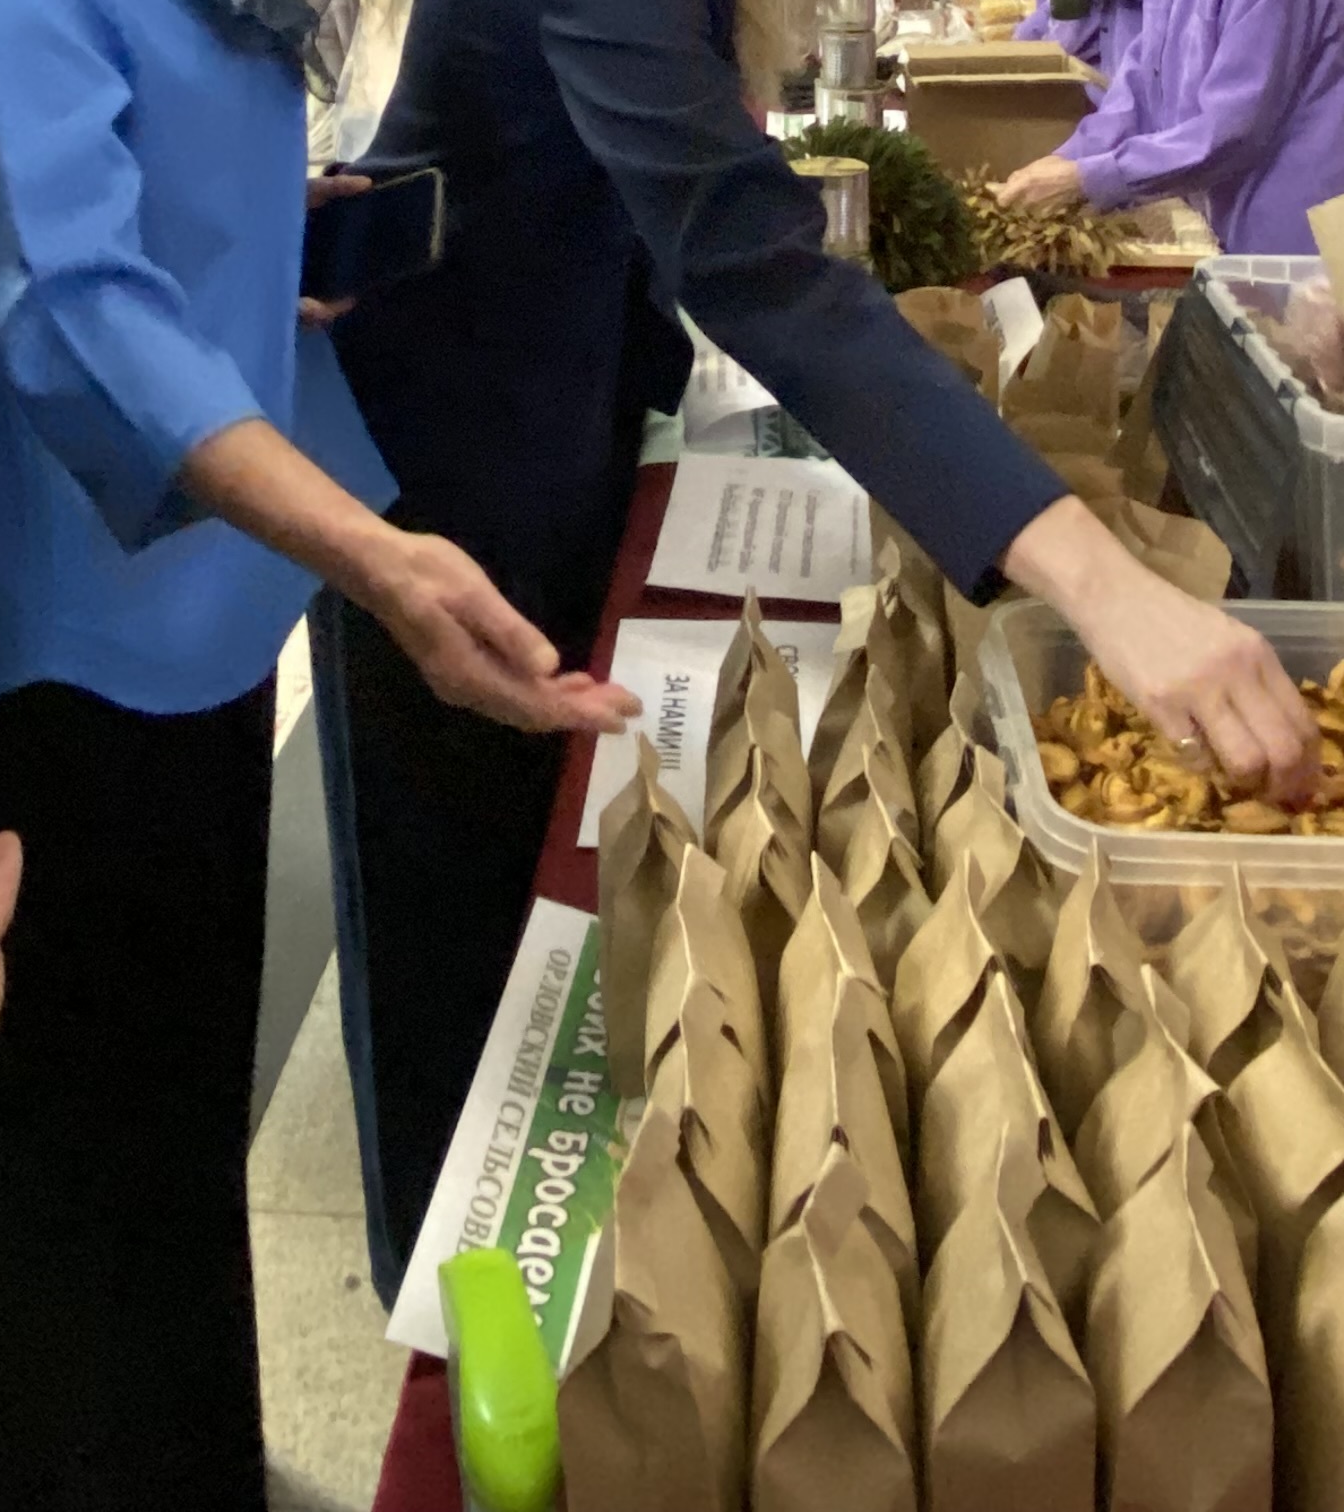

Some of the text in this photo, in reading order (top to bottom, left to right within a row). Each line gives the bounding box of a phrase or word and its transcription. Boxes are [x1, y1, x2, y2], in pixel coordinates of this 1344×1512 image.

[663, 674, 690, 694] ЗА
[457, 948, 572, 1254] ОРЛОВСКИЙ СЕЛЬСОВ
